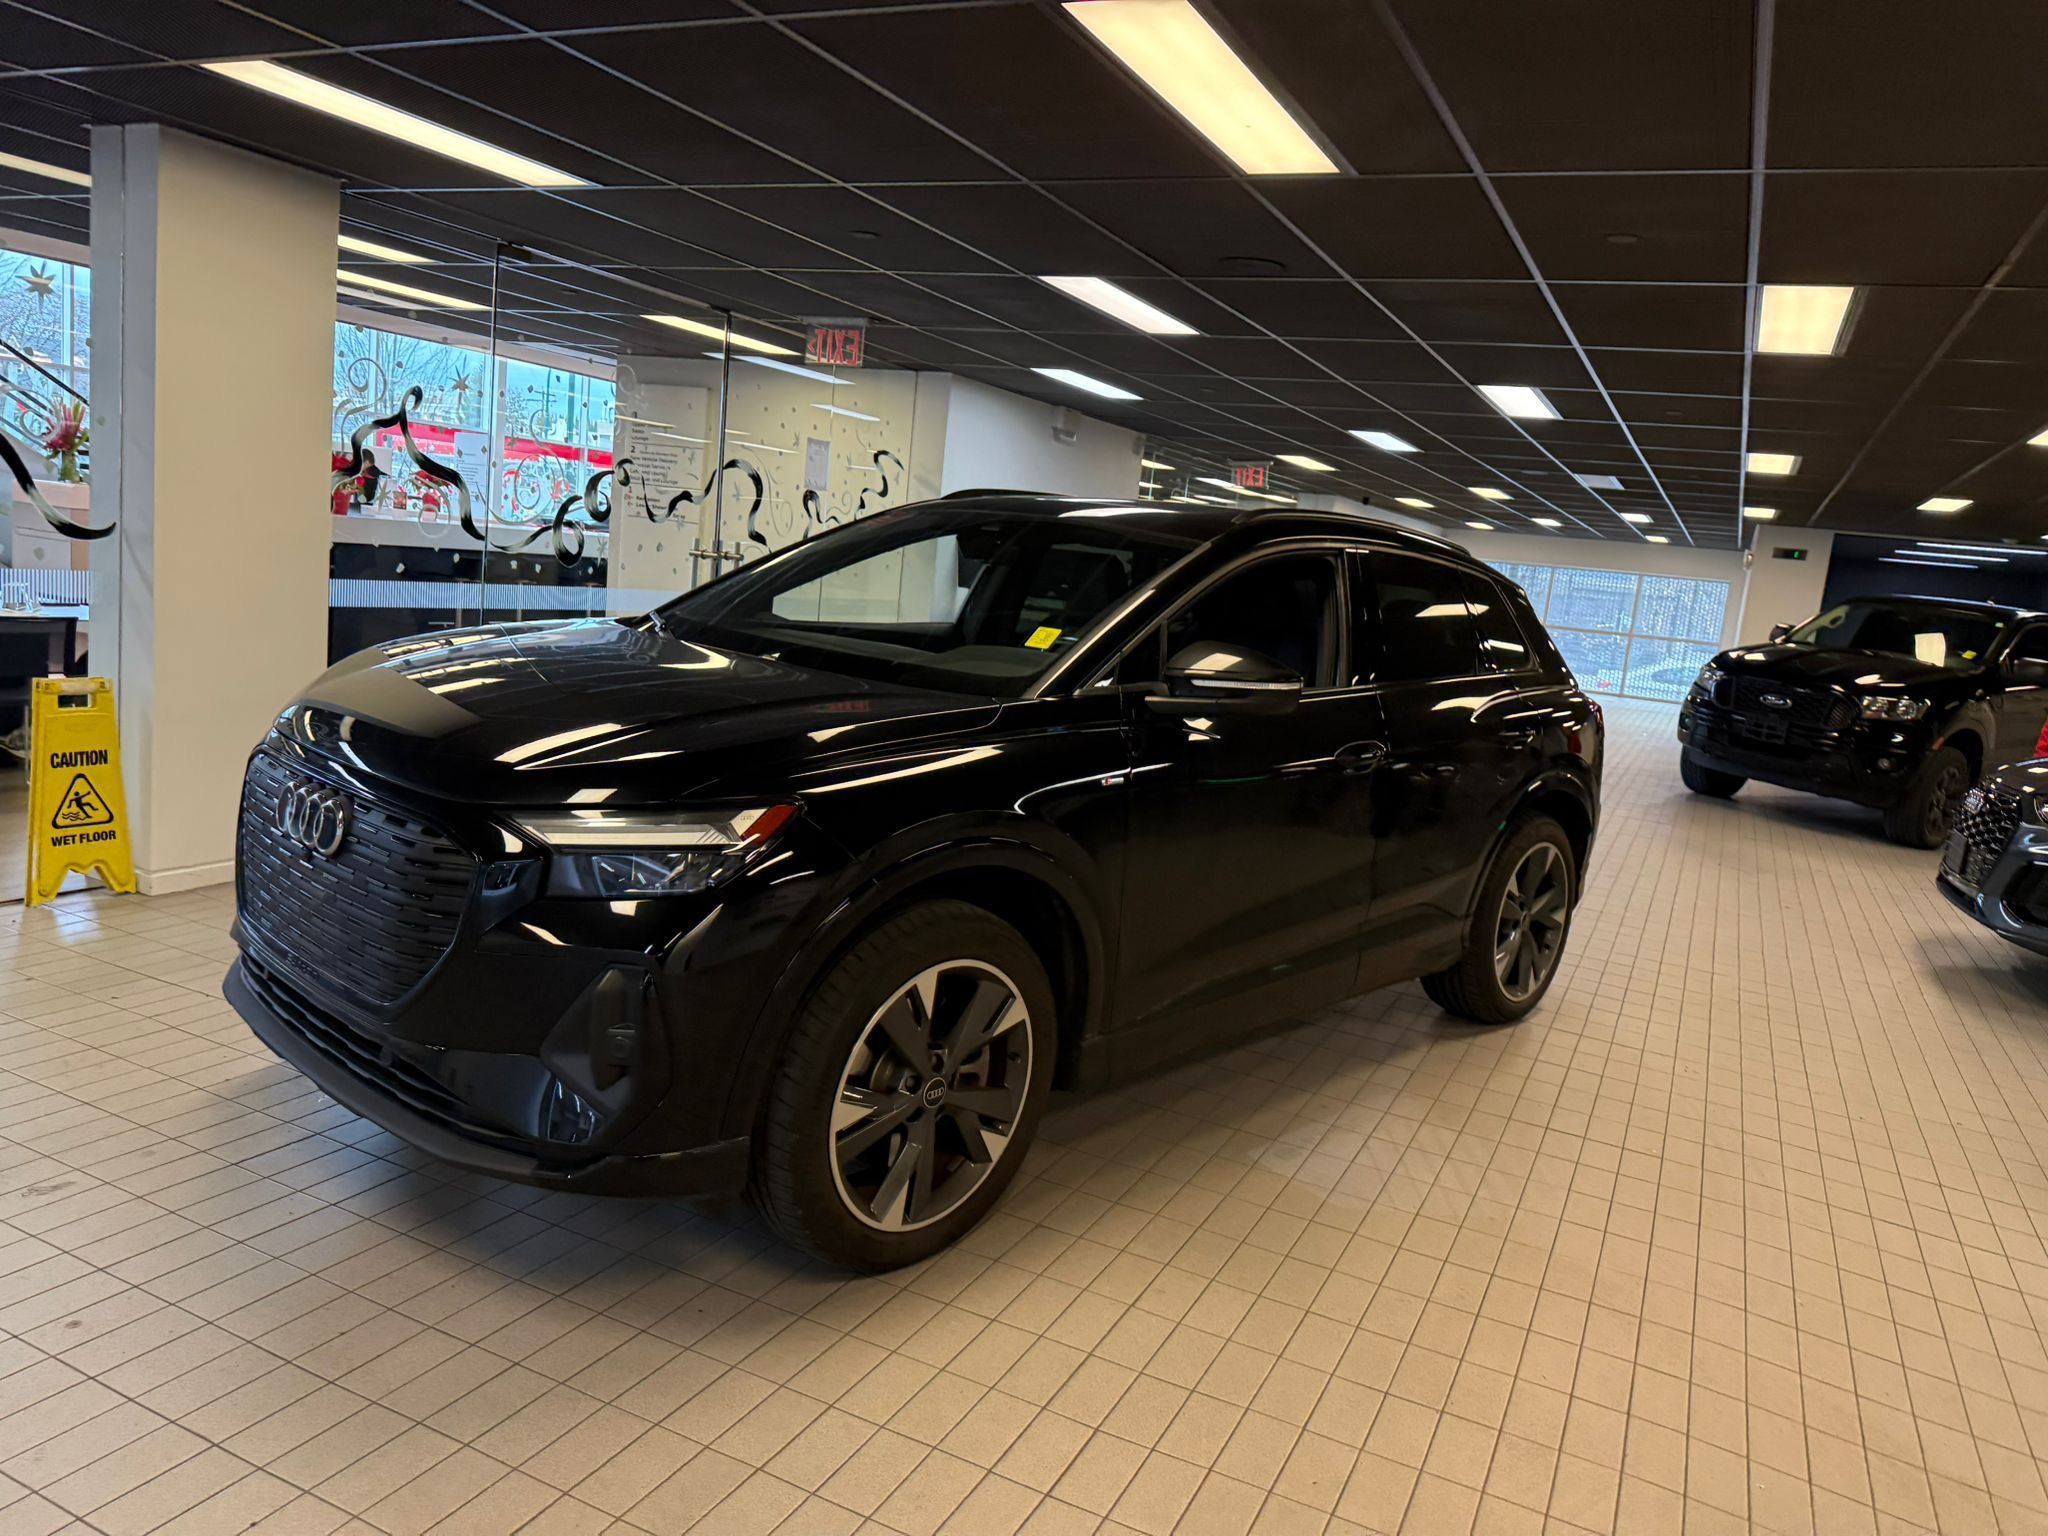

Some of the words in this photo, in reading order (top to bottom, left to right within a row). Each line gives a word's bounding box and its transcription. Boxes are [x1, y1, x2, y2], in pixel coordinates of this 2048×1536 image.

[630, 445, 636, 453] 2
[50, 749, 108, 769] CAUTION
[51, 834, 77, 847] WET
[79, 830, 116, 844] FLOOR
